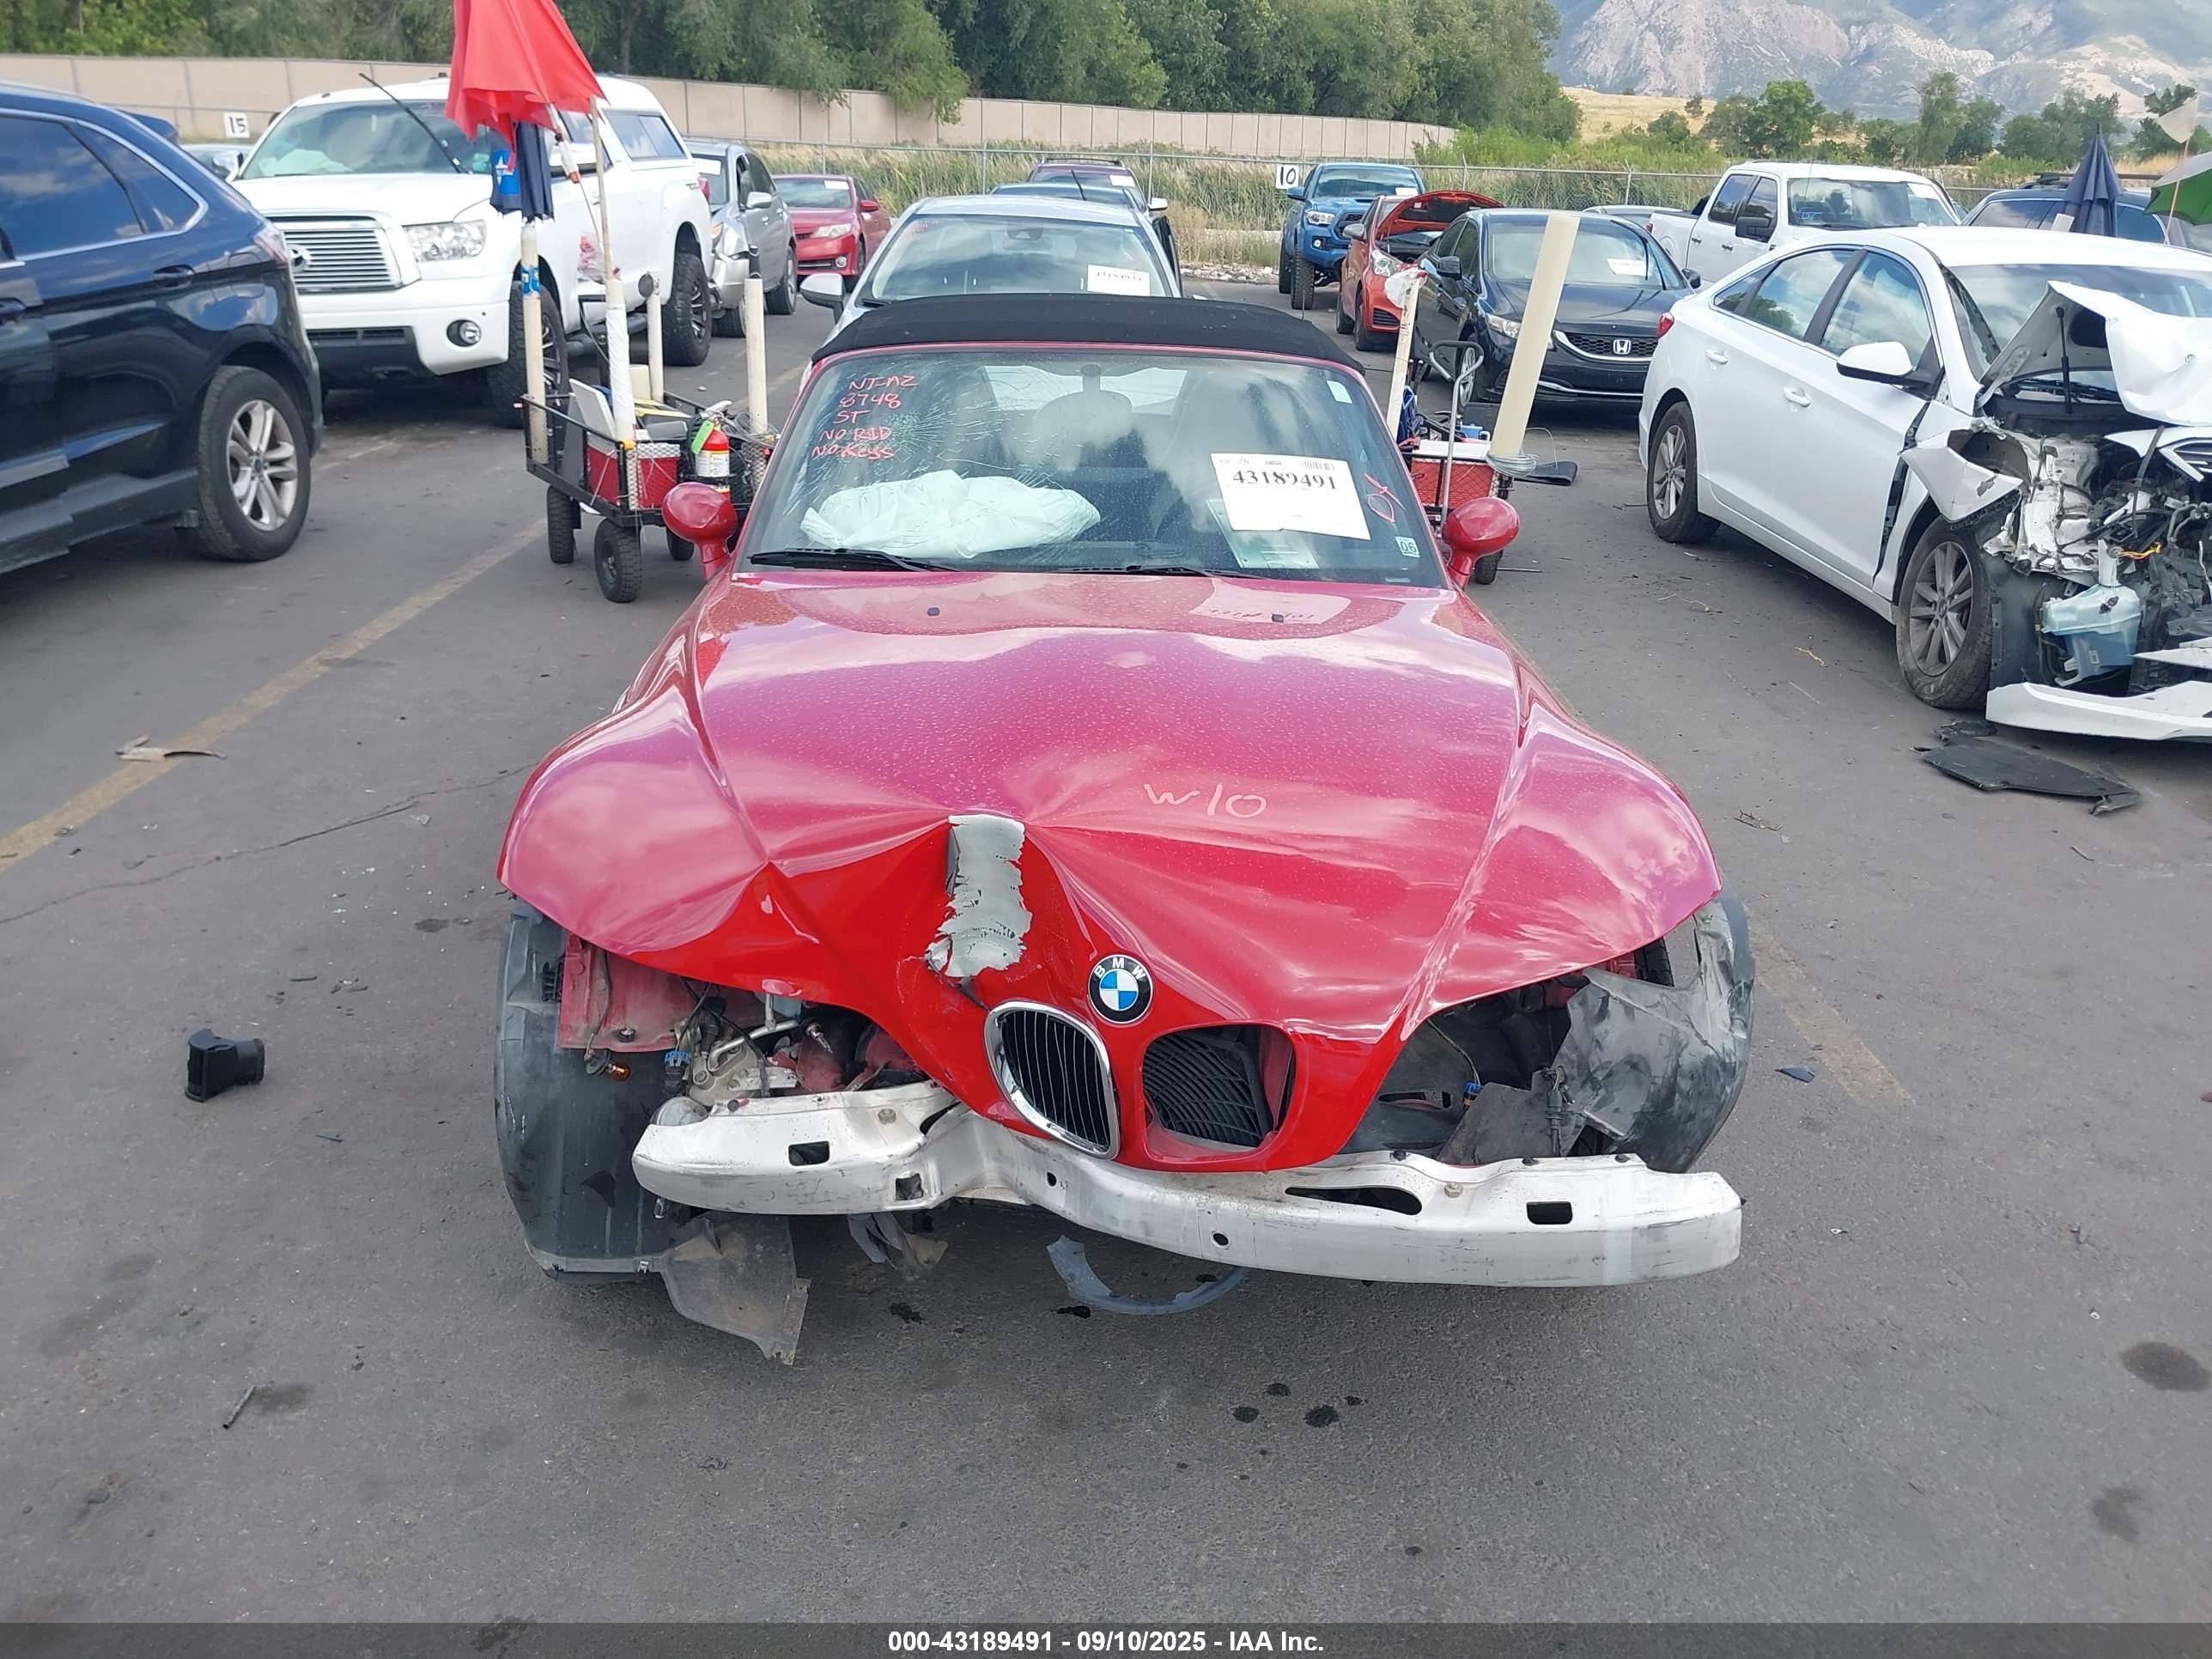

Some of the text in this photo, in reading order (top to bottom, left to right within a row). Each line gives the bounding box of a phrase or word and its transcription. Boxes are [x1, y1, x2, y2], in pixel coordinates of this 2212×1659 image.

[229, 116, 246, 134] 15
[1279, 166, 1297, 186] 10
[839, 392, 902, 409] 8748
[833, 410, 872, 424] ST
[1232, 470, 1336, 489] 43189491
[1400, 541, 1418, 554] 06
[1093, 957, 1146, 980] BMW
